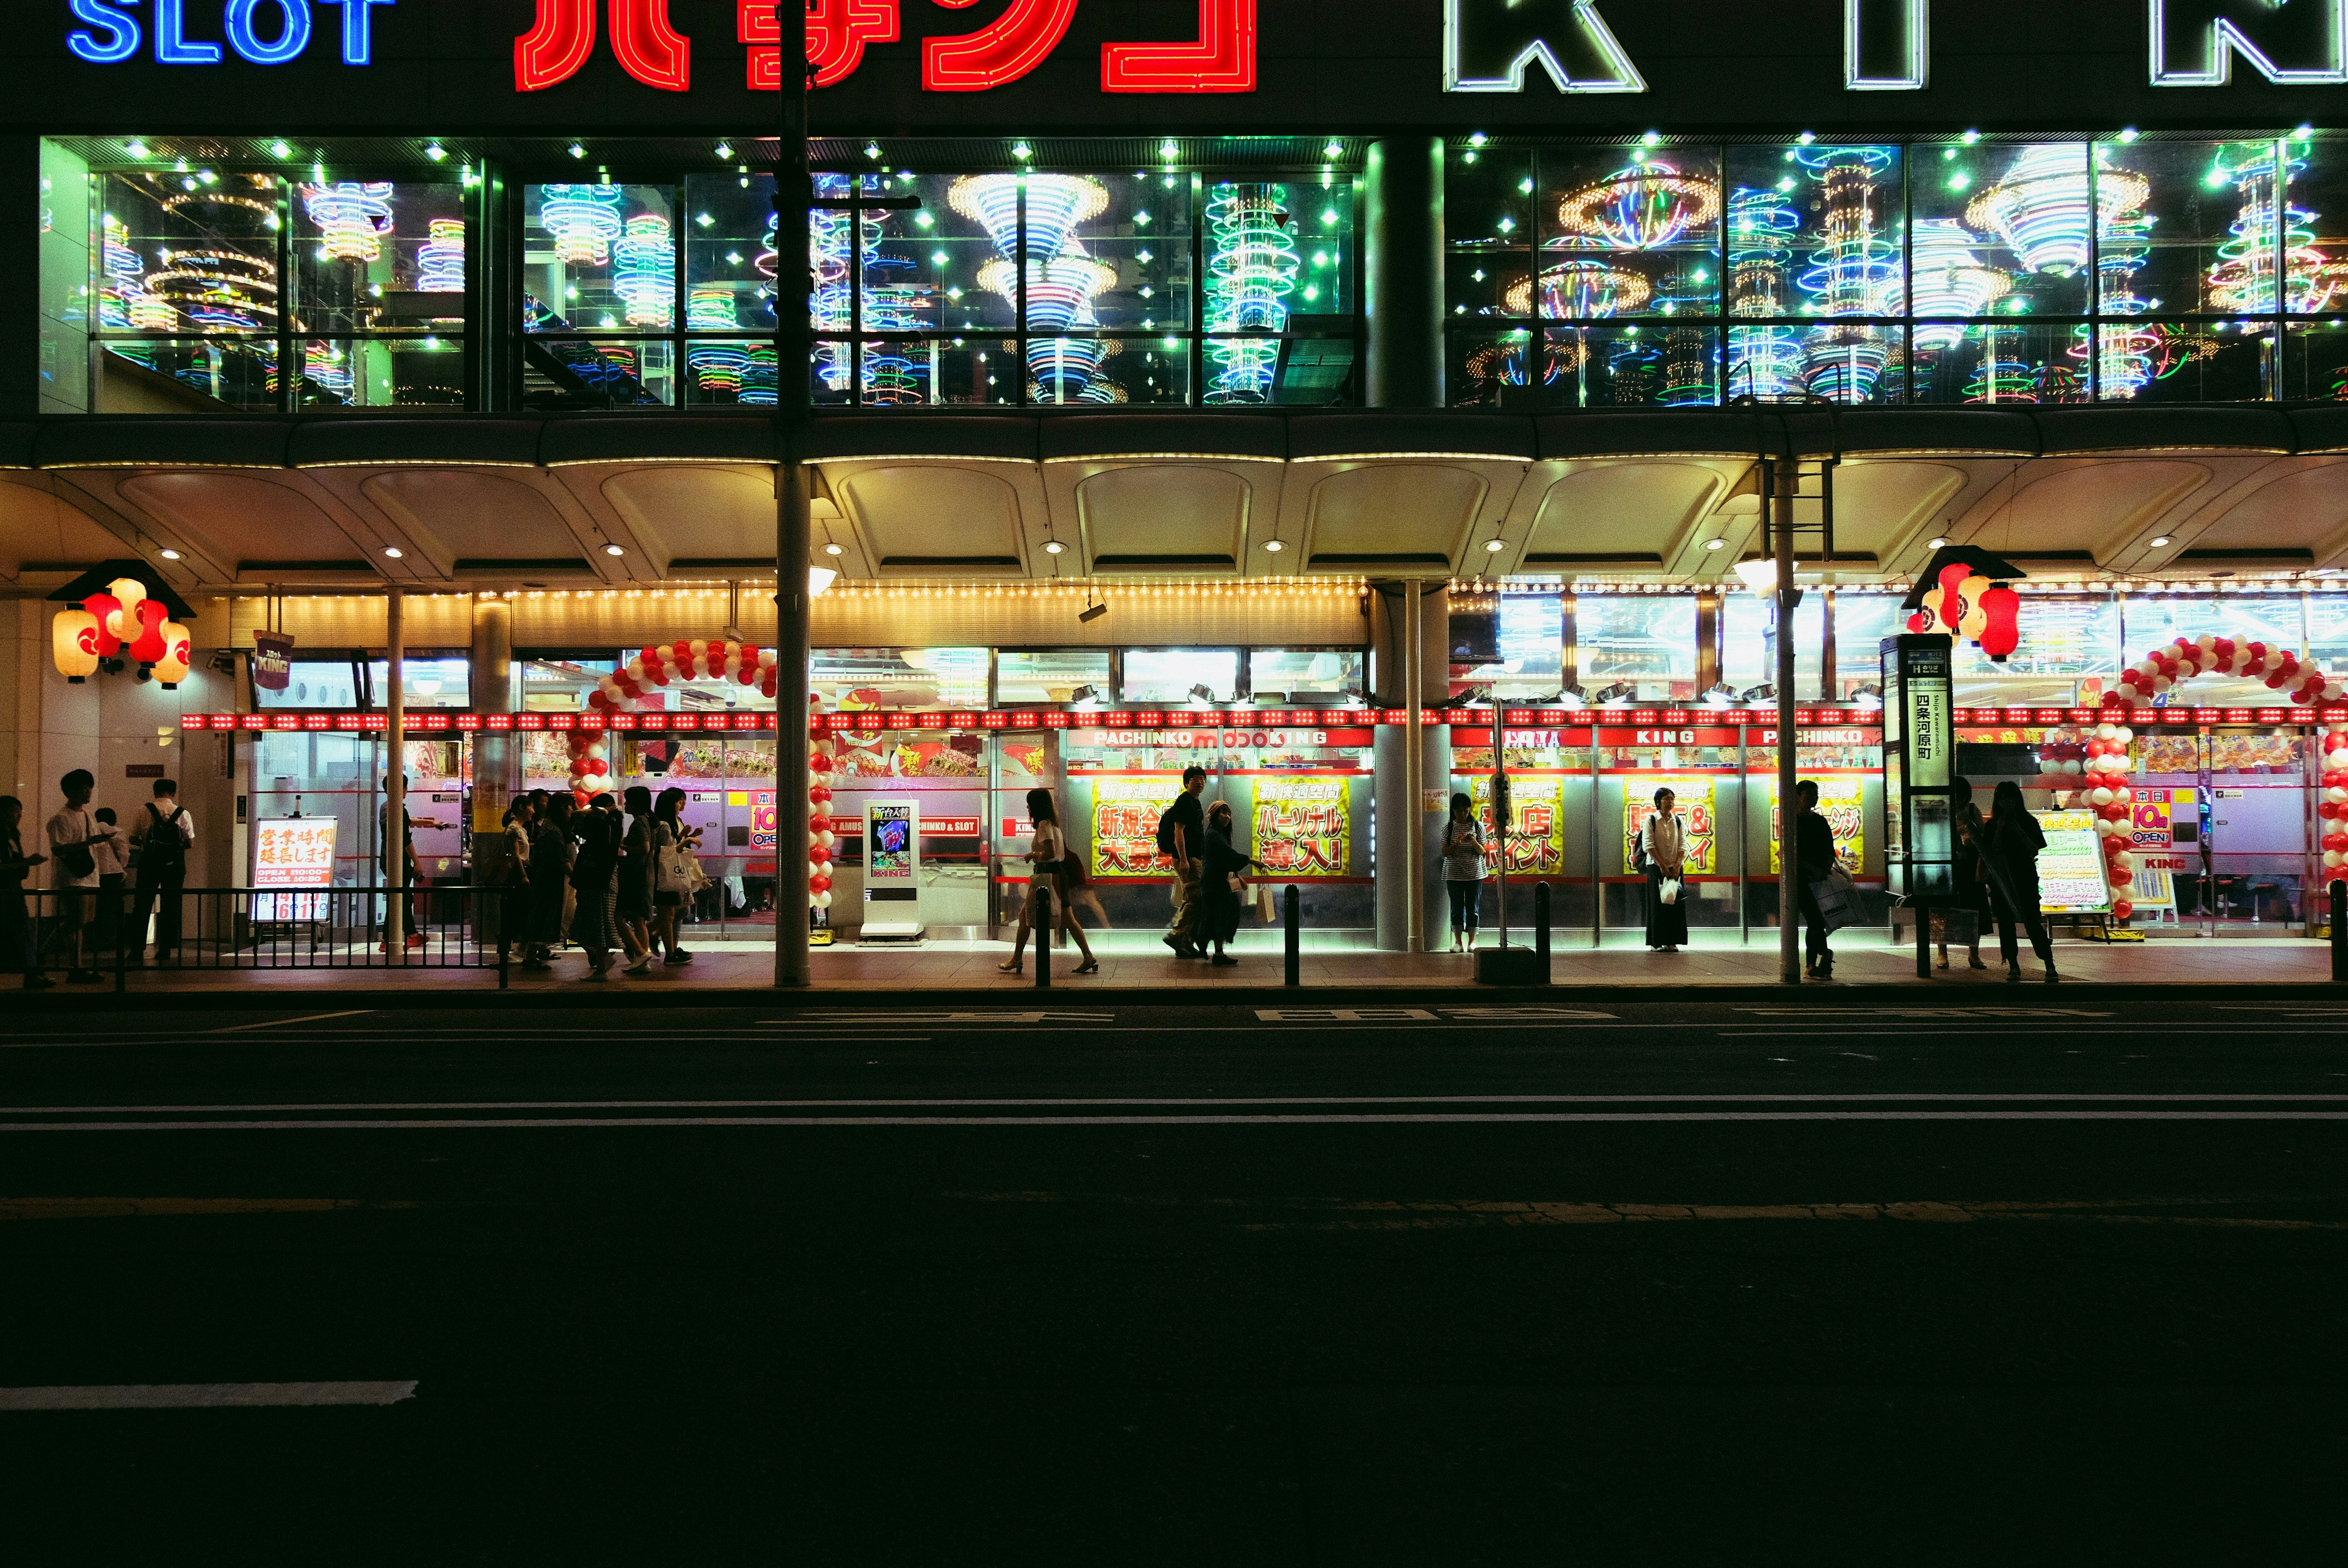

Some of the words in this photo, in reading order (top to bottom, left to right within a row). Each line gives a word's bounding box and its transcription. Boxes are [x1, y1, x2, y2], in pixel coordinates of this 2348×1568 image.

[67, 0, 395, 66] SLOT
[266, 649, 281, 659] スロット
[258, 656, 288, 674] KING
[1913, 665, 1921, 673] H
[1917, 695, 1931, 760] 四条河原町
[1094, 732, 1192, 745] PACHINKO
[1269, 732, 1327, 744] KING
[1637, 731, 1694, 743] KING
[1763, 731, 1863, 743] PCHINKO
[1099, 783, 1182, 800] 新快適空間
[1259, 783, 1341, 800] 新快適空間
[1475, 781, 1558, 800] 新適空間
[2137, 791, 2165, 803] 本日
[758, 793, 777, 803] 本
[872, 807, 909, 820] 新台入替
[2132, 805, 2168, 830] 10時
[840, 822, 862, 831] AMUS
[919, 822, 946, 831] HINKO
[947, 823, 954, 831] &
[955, 822, 975, 831] SLOT
[1099, 806, 1173, 838] 新規会
[1258, 805, 1343, 838] パーソナル
[2037, 817, 2093, 829] 快適空間
[260, 828, 334, 846] 営業時間
[753, 833, 777, 845] OPE
[2132, 831, 2168, 843] OPEN!
[259, 846, 331, 864] 延長します
[1260, 838, 1342, 871] 導入!
[1484, 837, 1561, 870] ポイント
[673, 866, 685, 874] GU
[2145, 858, 2186, 869] KING
